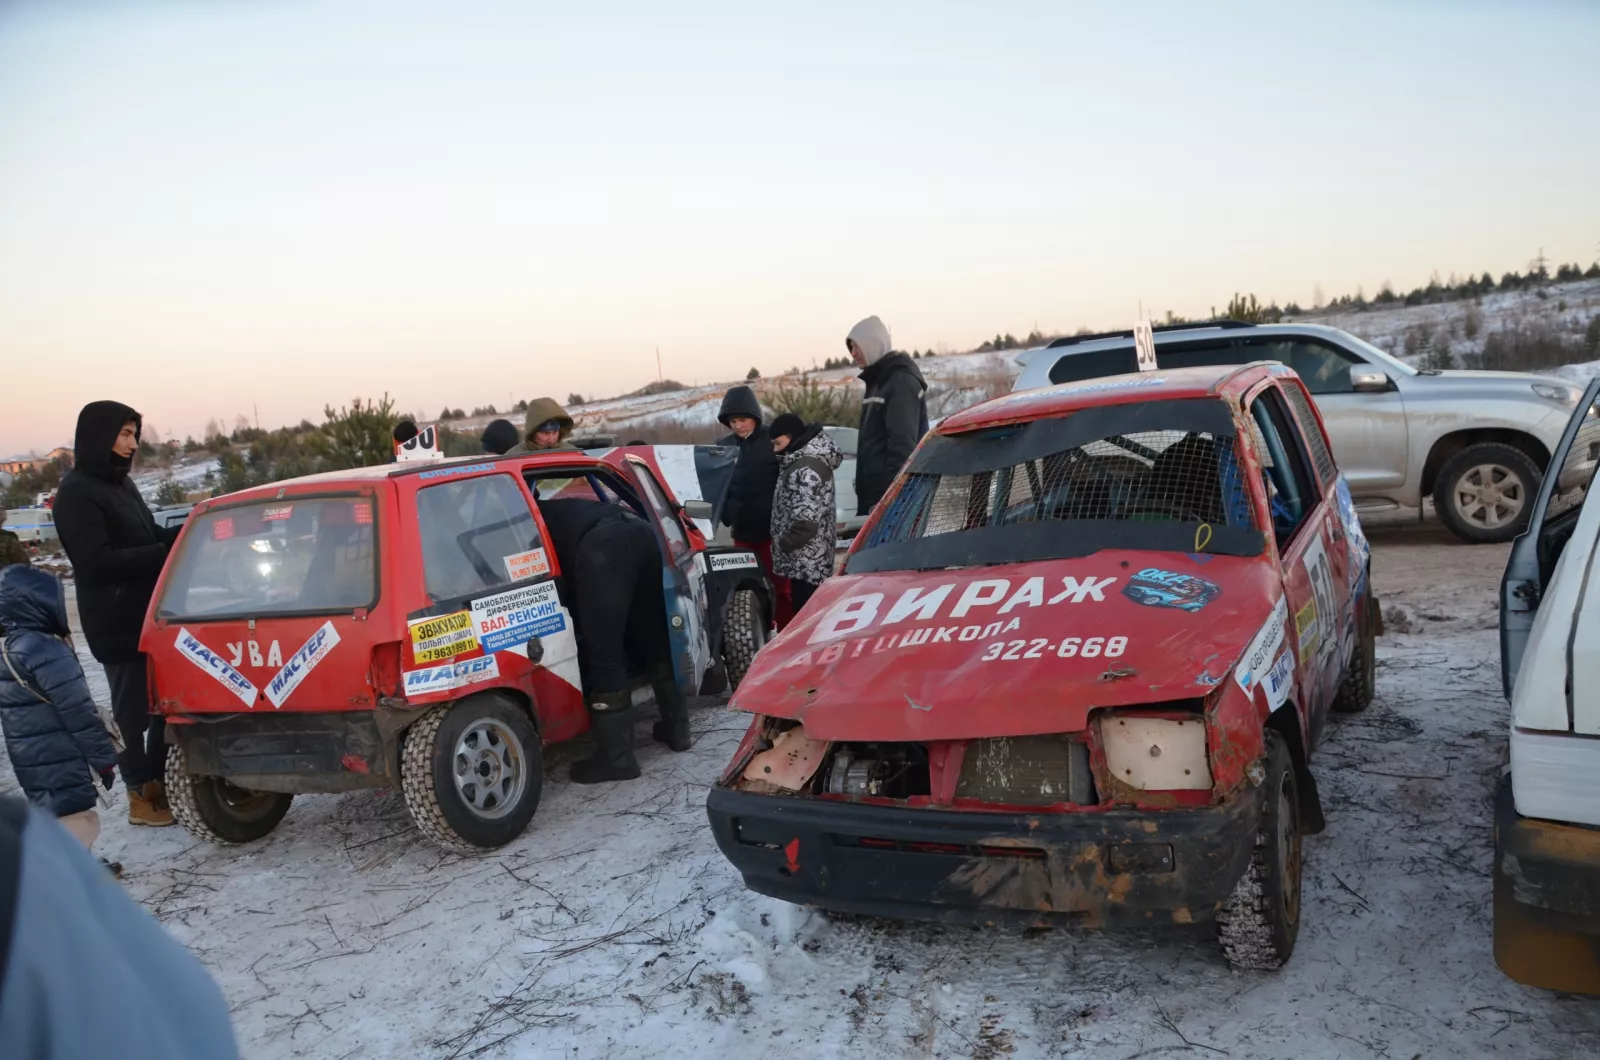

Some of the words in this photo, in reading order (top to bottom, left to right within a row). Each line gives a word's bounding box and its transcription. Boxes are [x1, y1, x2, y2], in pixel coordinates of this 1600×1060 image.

[1136, 326, 1154, 364] 50
[474, 584, 555, 610] САМОБЛОКИРУЮЩИЕСЯ
[487, 594, 549, 618] ДИФФЕРЕНЦИАЛЫ
[806, 576, 1117, 645] ВИРАЖ
[418, 613, 467, 639] ЭВАКУАТОР
[481, 601, 557, 633] ВАЛ-РЕЙСИНГ
[226, 640, 283, 667] УВА
[270, 628, 327, 695] МАСТЕР
[307, 642, 330, 671] СПОРТ
[981, 636, 1129, 661] 322-668
[183, 635, 251, 691] МАСТЕР
[408, 656, 494, 685] МАСТЕР
[466, 670, 493, 682] СПОРТ
[218, 675, 245, 697] СПОРТ
